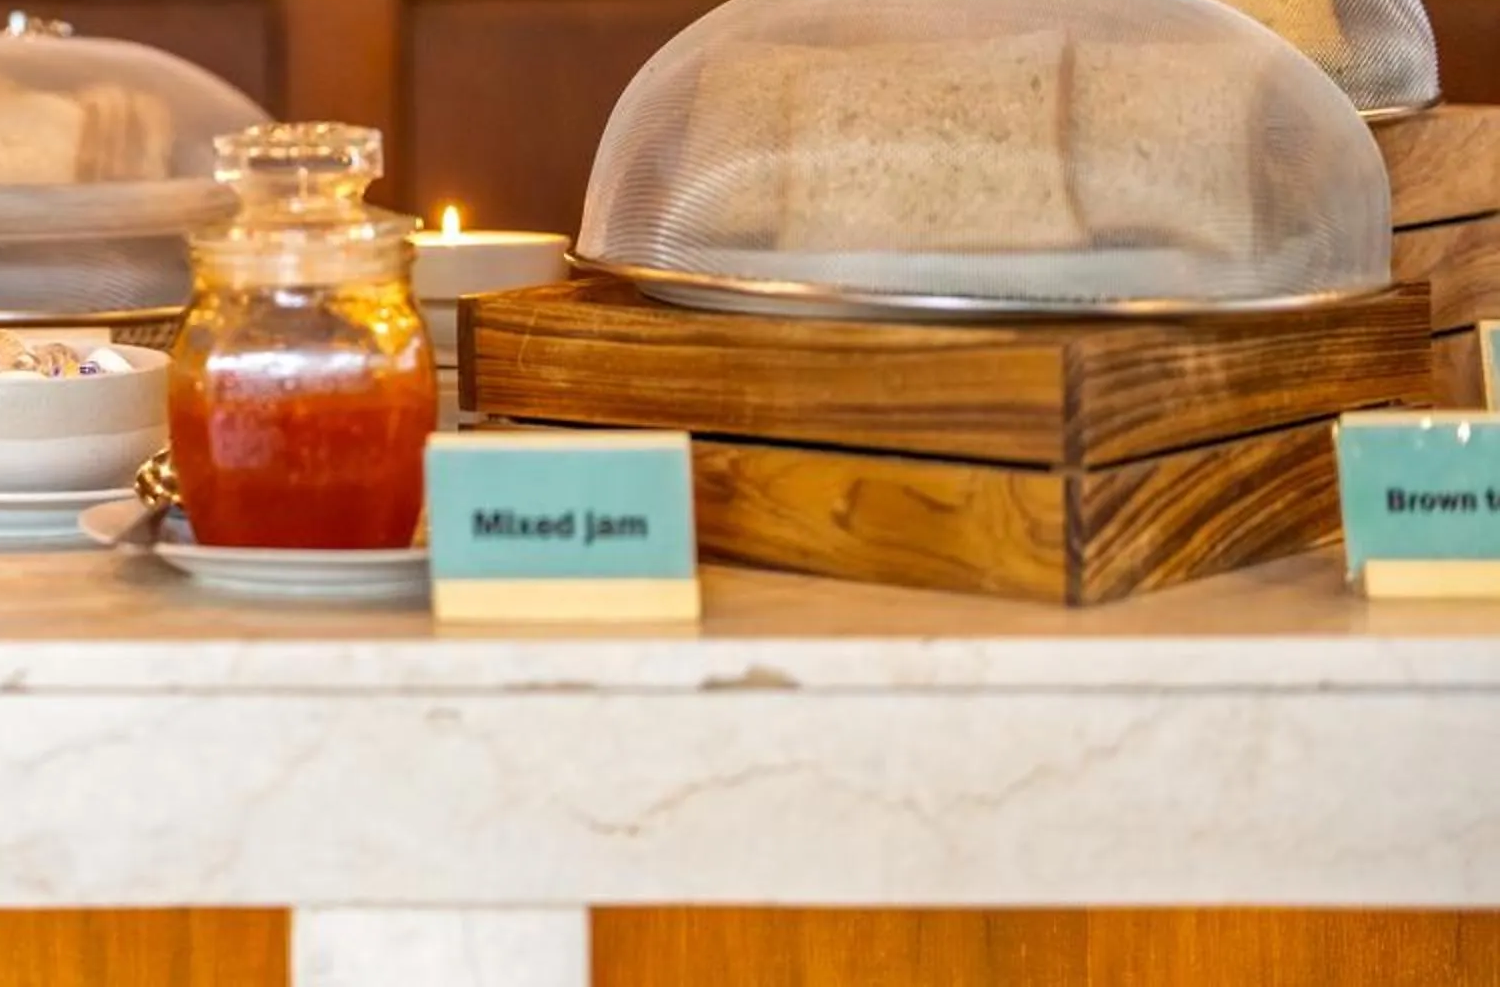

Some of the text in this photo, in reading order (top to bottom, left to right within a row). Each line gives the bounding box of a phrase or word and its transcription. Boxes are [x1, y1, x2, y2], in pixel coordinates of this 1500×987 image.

[1387, 486, 1500, 513] Brown t
[472, 509, 648, 546] Mixed jam
